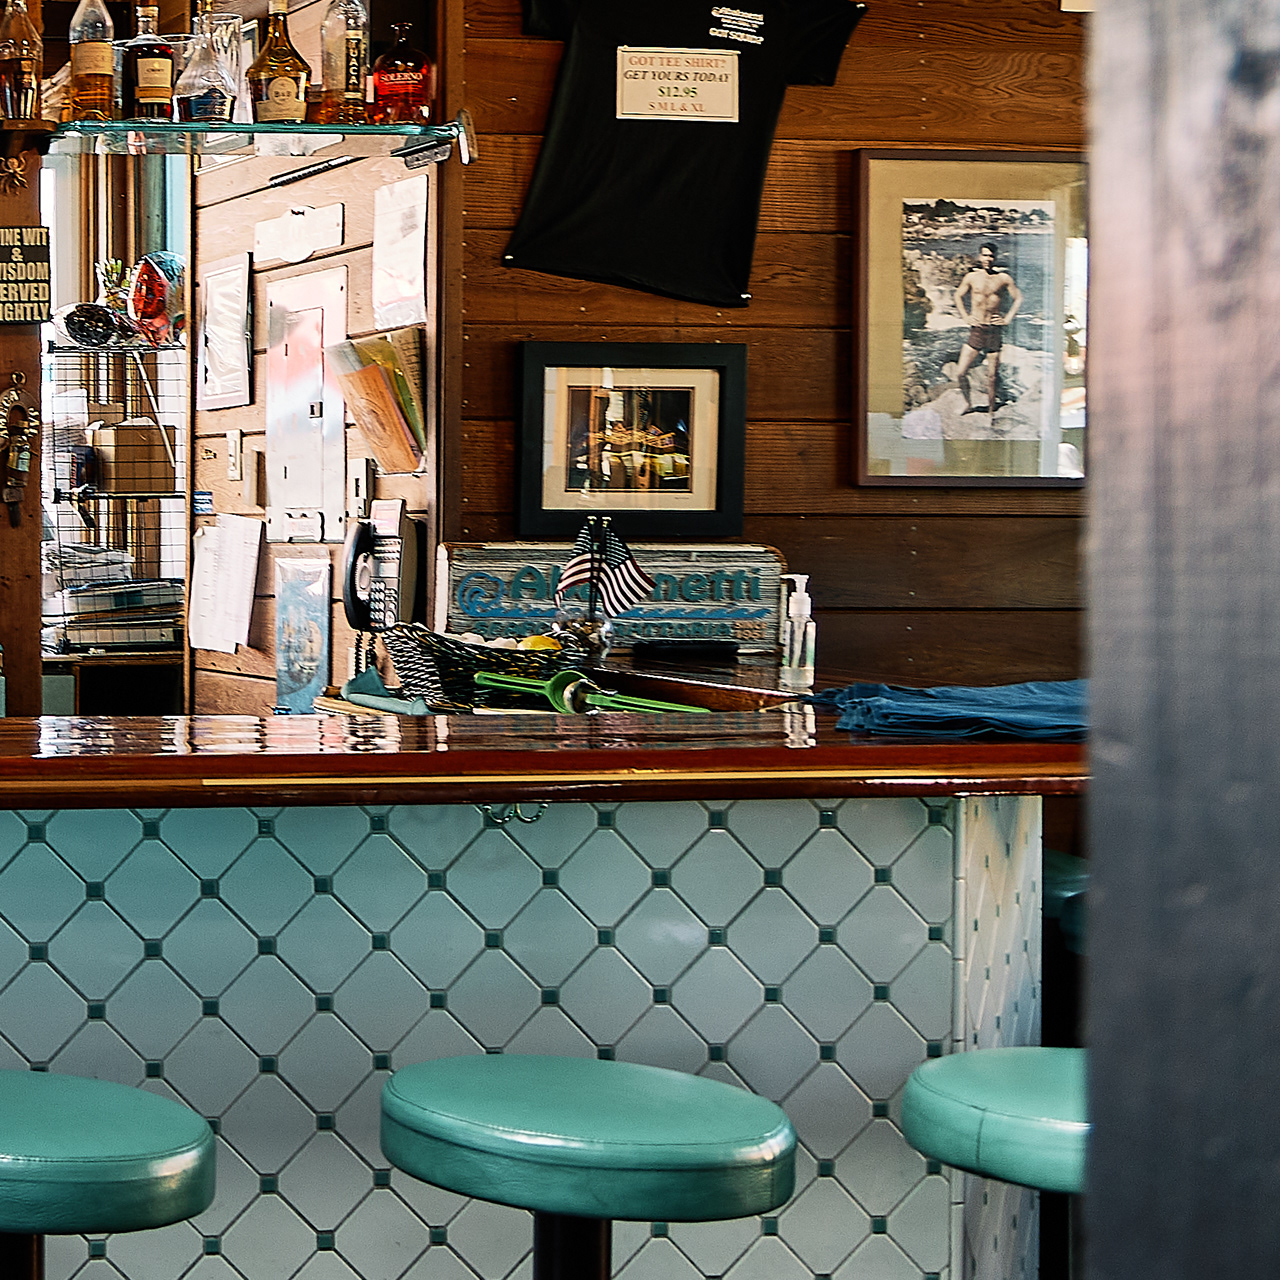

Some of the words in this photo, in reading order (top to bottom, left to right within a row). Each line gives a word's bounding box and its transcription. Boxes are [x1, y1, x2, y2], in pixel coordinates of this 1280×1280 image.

[628, 56, 655, 66] GOT
[658, 57, 681, 67] TEE
[684, 58, 727, 69] SHIRT?
[623, 70, 648, 80] GET
[651, 70, 690, 81] YOURS
[692, 72, 731, 83] TODAY
[658, 86, 698, 98] $12.95
[648, 102, 656, 111] S
[658, 102, 668, 111] M
[690, 103, 705, 112] XL
[22, 228, 48, 246] WIT
[11, 247, 23, 261] &
